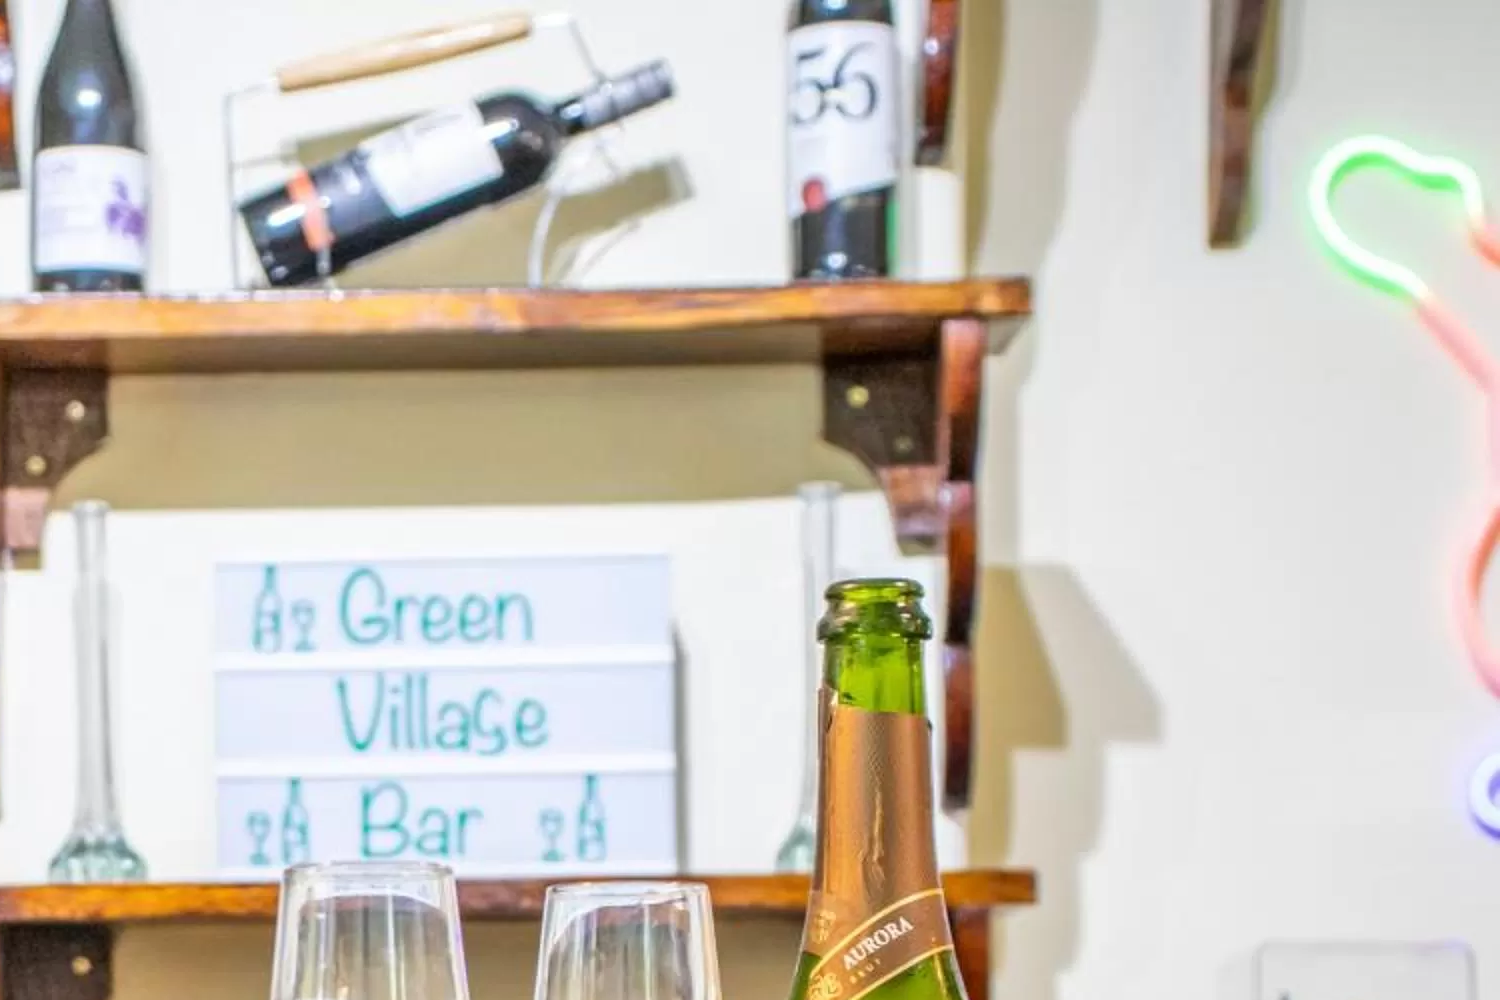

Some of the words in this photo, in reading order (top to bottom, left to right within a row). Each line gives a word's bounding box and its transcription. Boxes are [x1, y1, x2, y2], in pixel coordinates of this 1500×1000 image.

[791, 41, 877, 125] 56
[338, 566, 535, 646] Green
[336, 670, 550, 757] Village
[359, 780, 485, 859] Bar
[842, 916, 914, 970] AURORA
